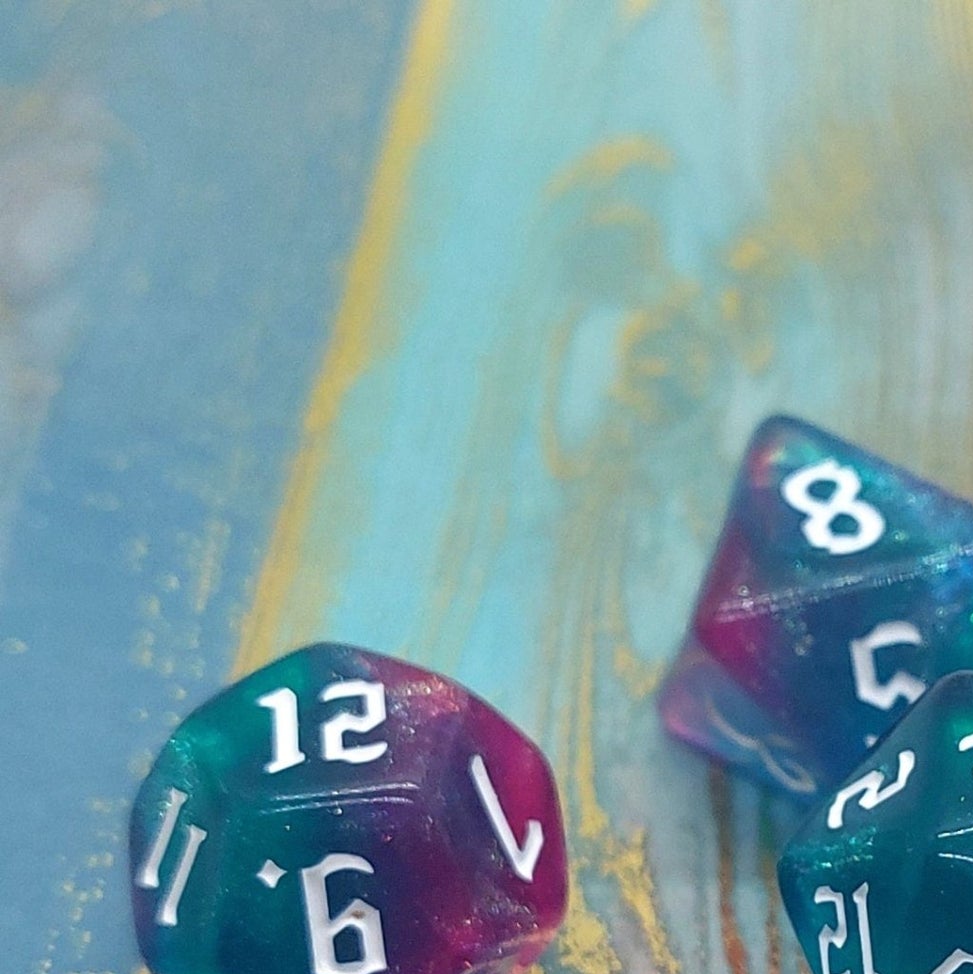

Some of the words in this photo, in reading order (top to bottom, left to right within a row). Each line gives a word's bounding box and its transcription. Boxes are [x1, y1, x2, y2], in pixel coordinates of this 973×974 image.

[781, 458, 886, 555] 8
[256, 680, 388, 773] 12
[135, 788, 207, 926] 11
